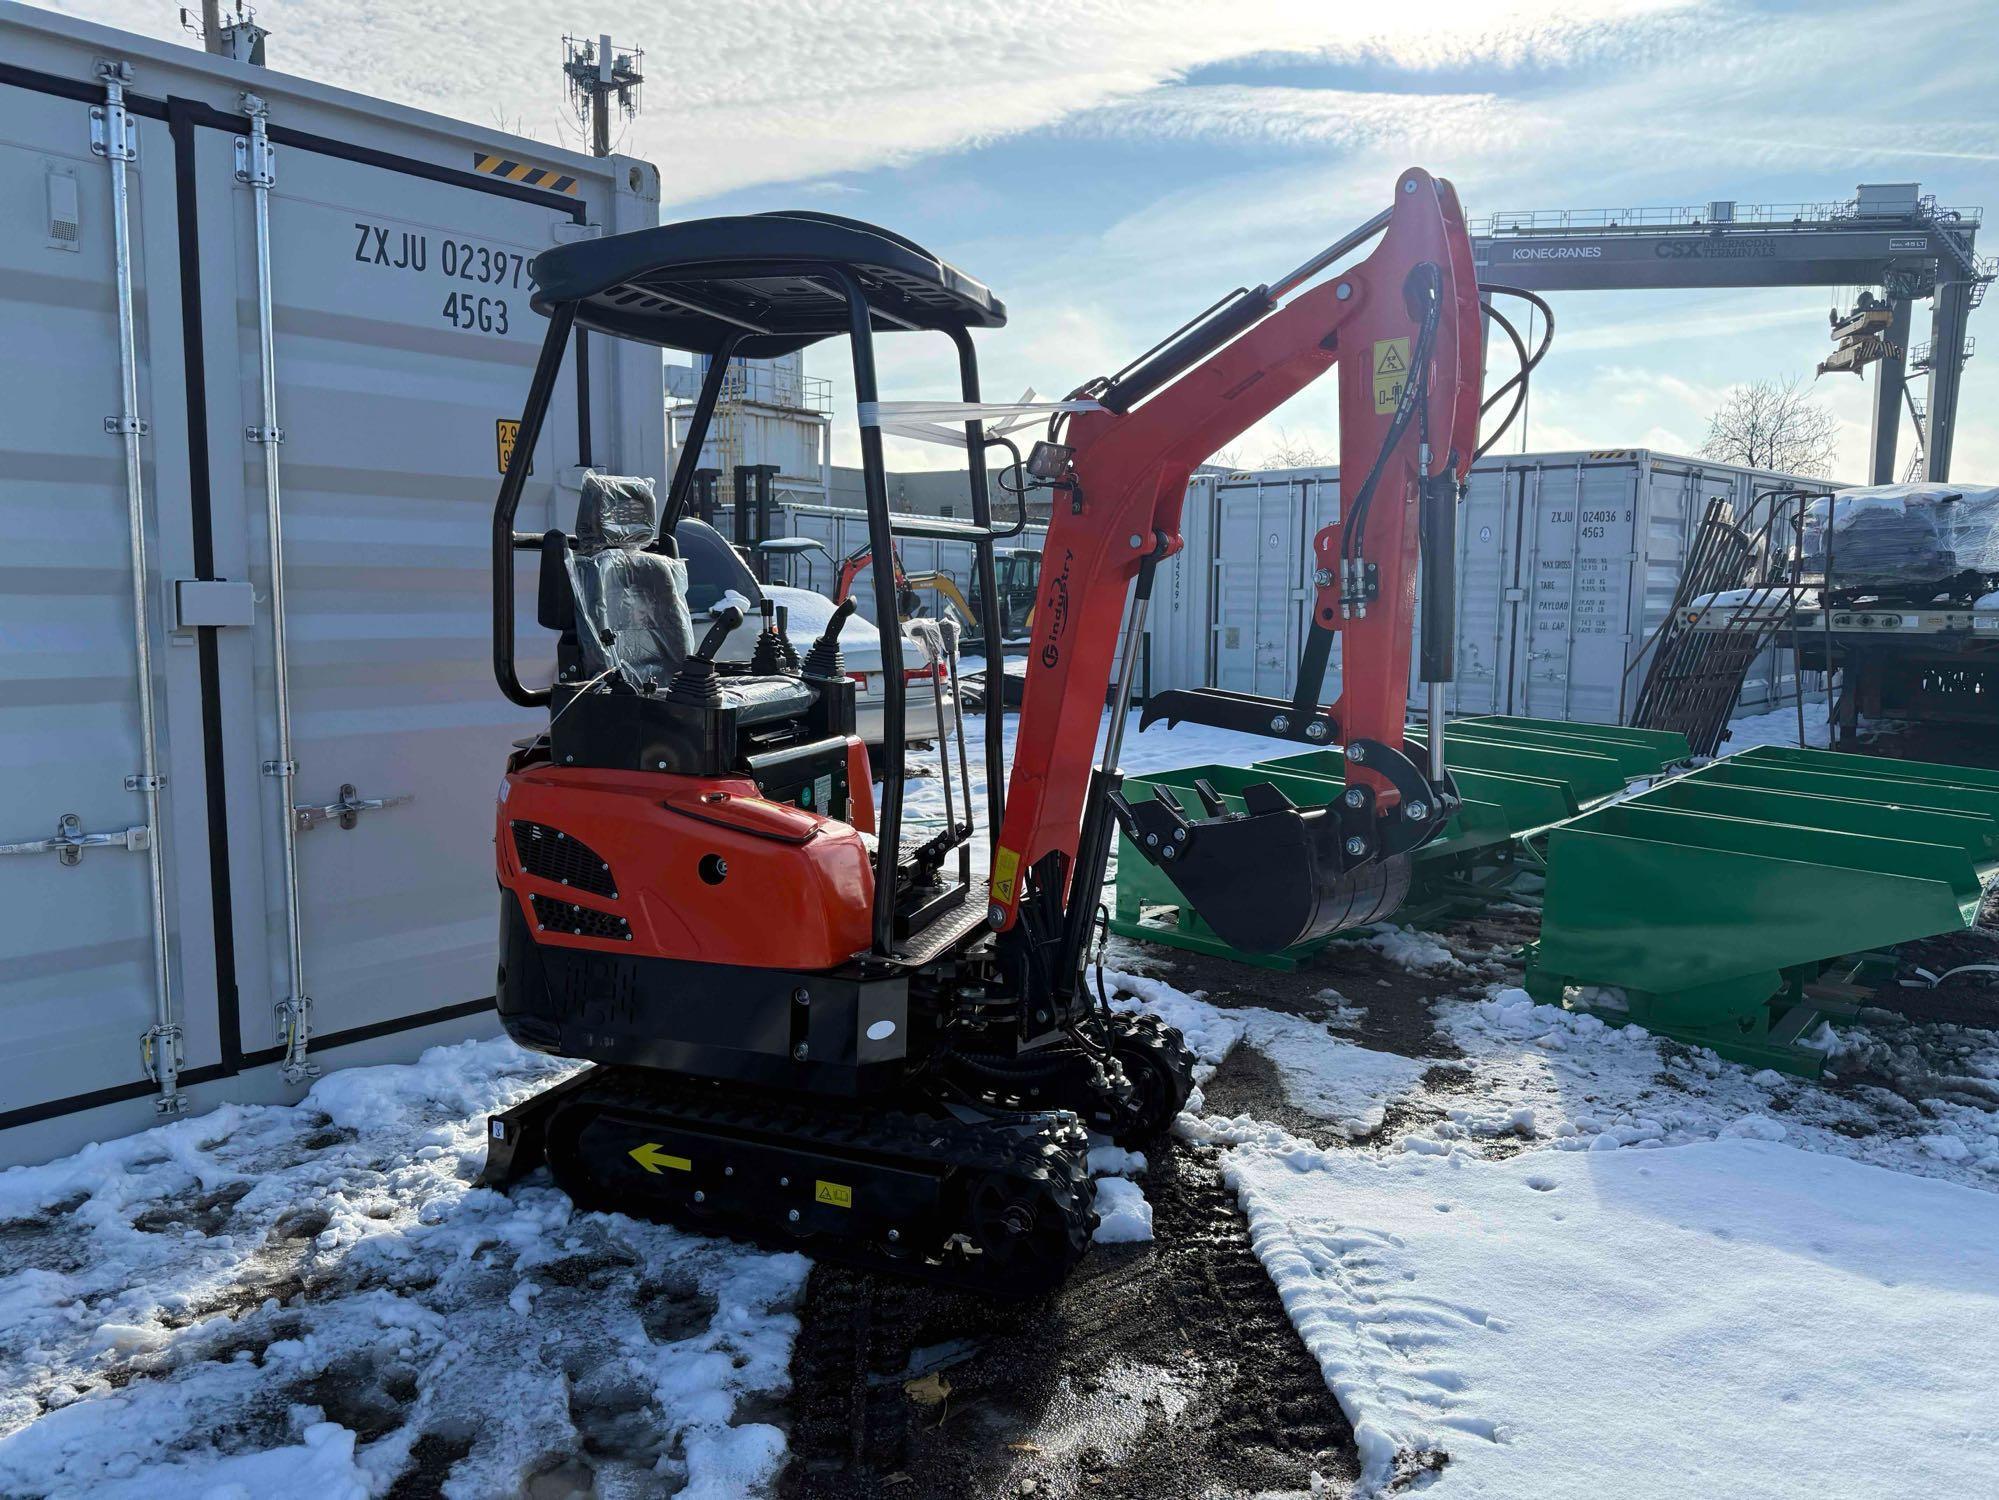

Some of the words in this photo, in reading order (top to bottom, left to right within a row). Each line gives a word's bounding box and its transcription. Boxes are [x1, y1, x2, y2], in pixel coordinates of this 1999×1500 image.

[355, 223, 427, 272] ZXJU
[1654, 239, 1703, 259] CSX
[1703, 238, 1777, 249] INTERMODAL
[1512, 246, 1602, 260] KONECRANES
[1703, 247, 1776, 259] TERMINALS
[442, 291, 509, 335] 45G3
[1551, 511, 1573, 523] ZXJU
[1582, 511, 1616, 523] 024036
[1625, 510, 1632, 522] 8
[1581, 526, 1605, 538] 45G3
[1540, 580, 1556, 591] TARE
[1538, 601, 1569, 611] PAYLOAD
